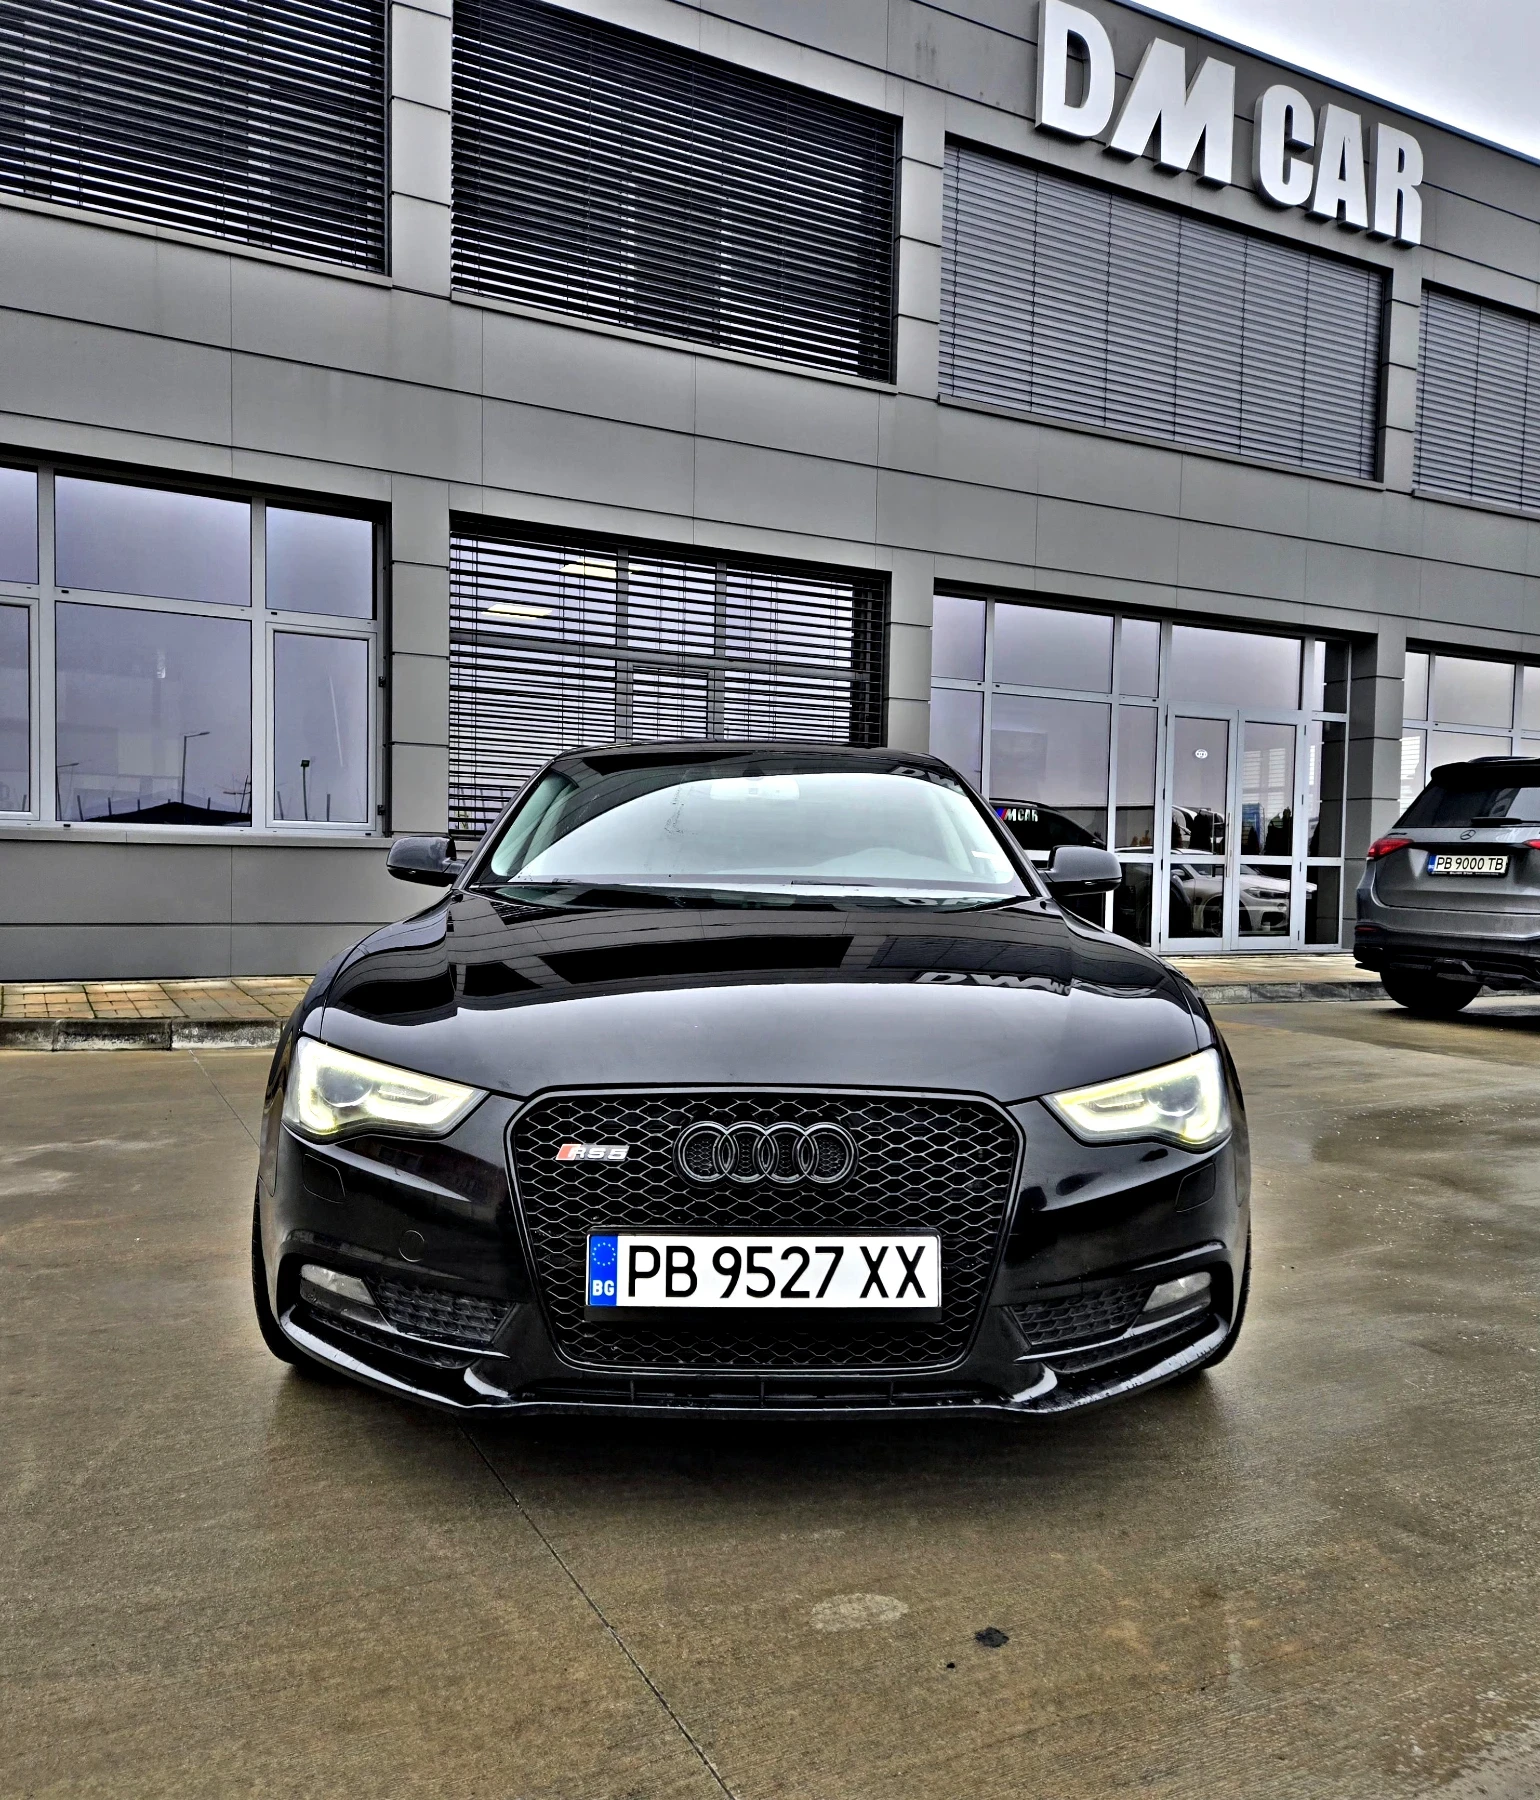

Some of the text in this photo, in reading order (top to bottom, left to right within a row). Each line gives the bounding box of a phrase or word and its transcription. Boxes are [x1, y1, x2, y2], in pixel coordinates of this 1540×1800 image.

[1036, 0, 1423, 245] DM CAR
[1436, 857, 1453, 870] PB
[1455, 857, 1485, 870] 9000
[1488, 857, 1504, 871] TB
[592, 1279, 615, 1297] BG
[628, 1245, 926, 1299] PB 9527 XX
